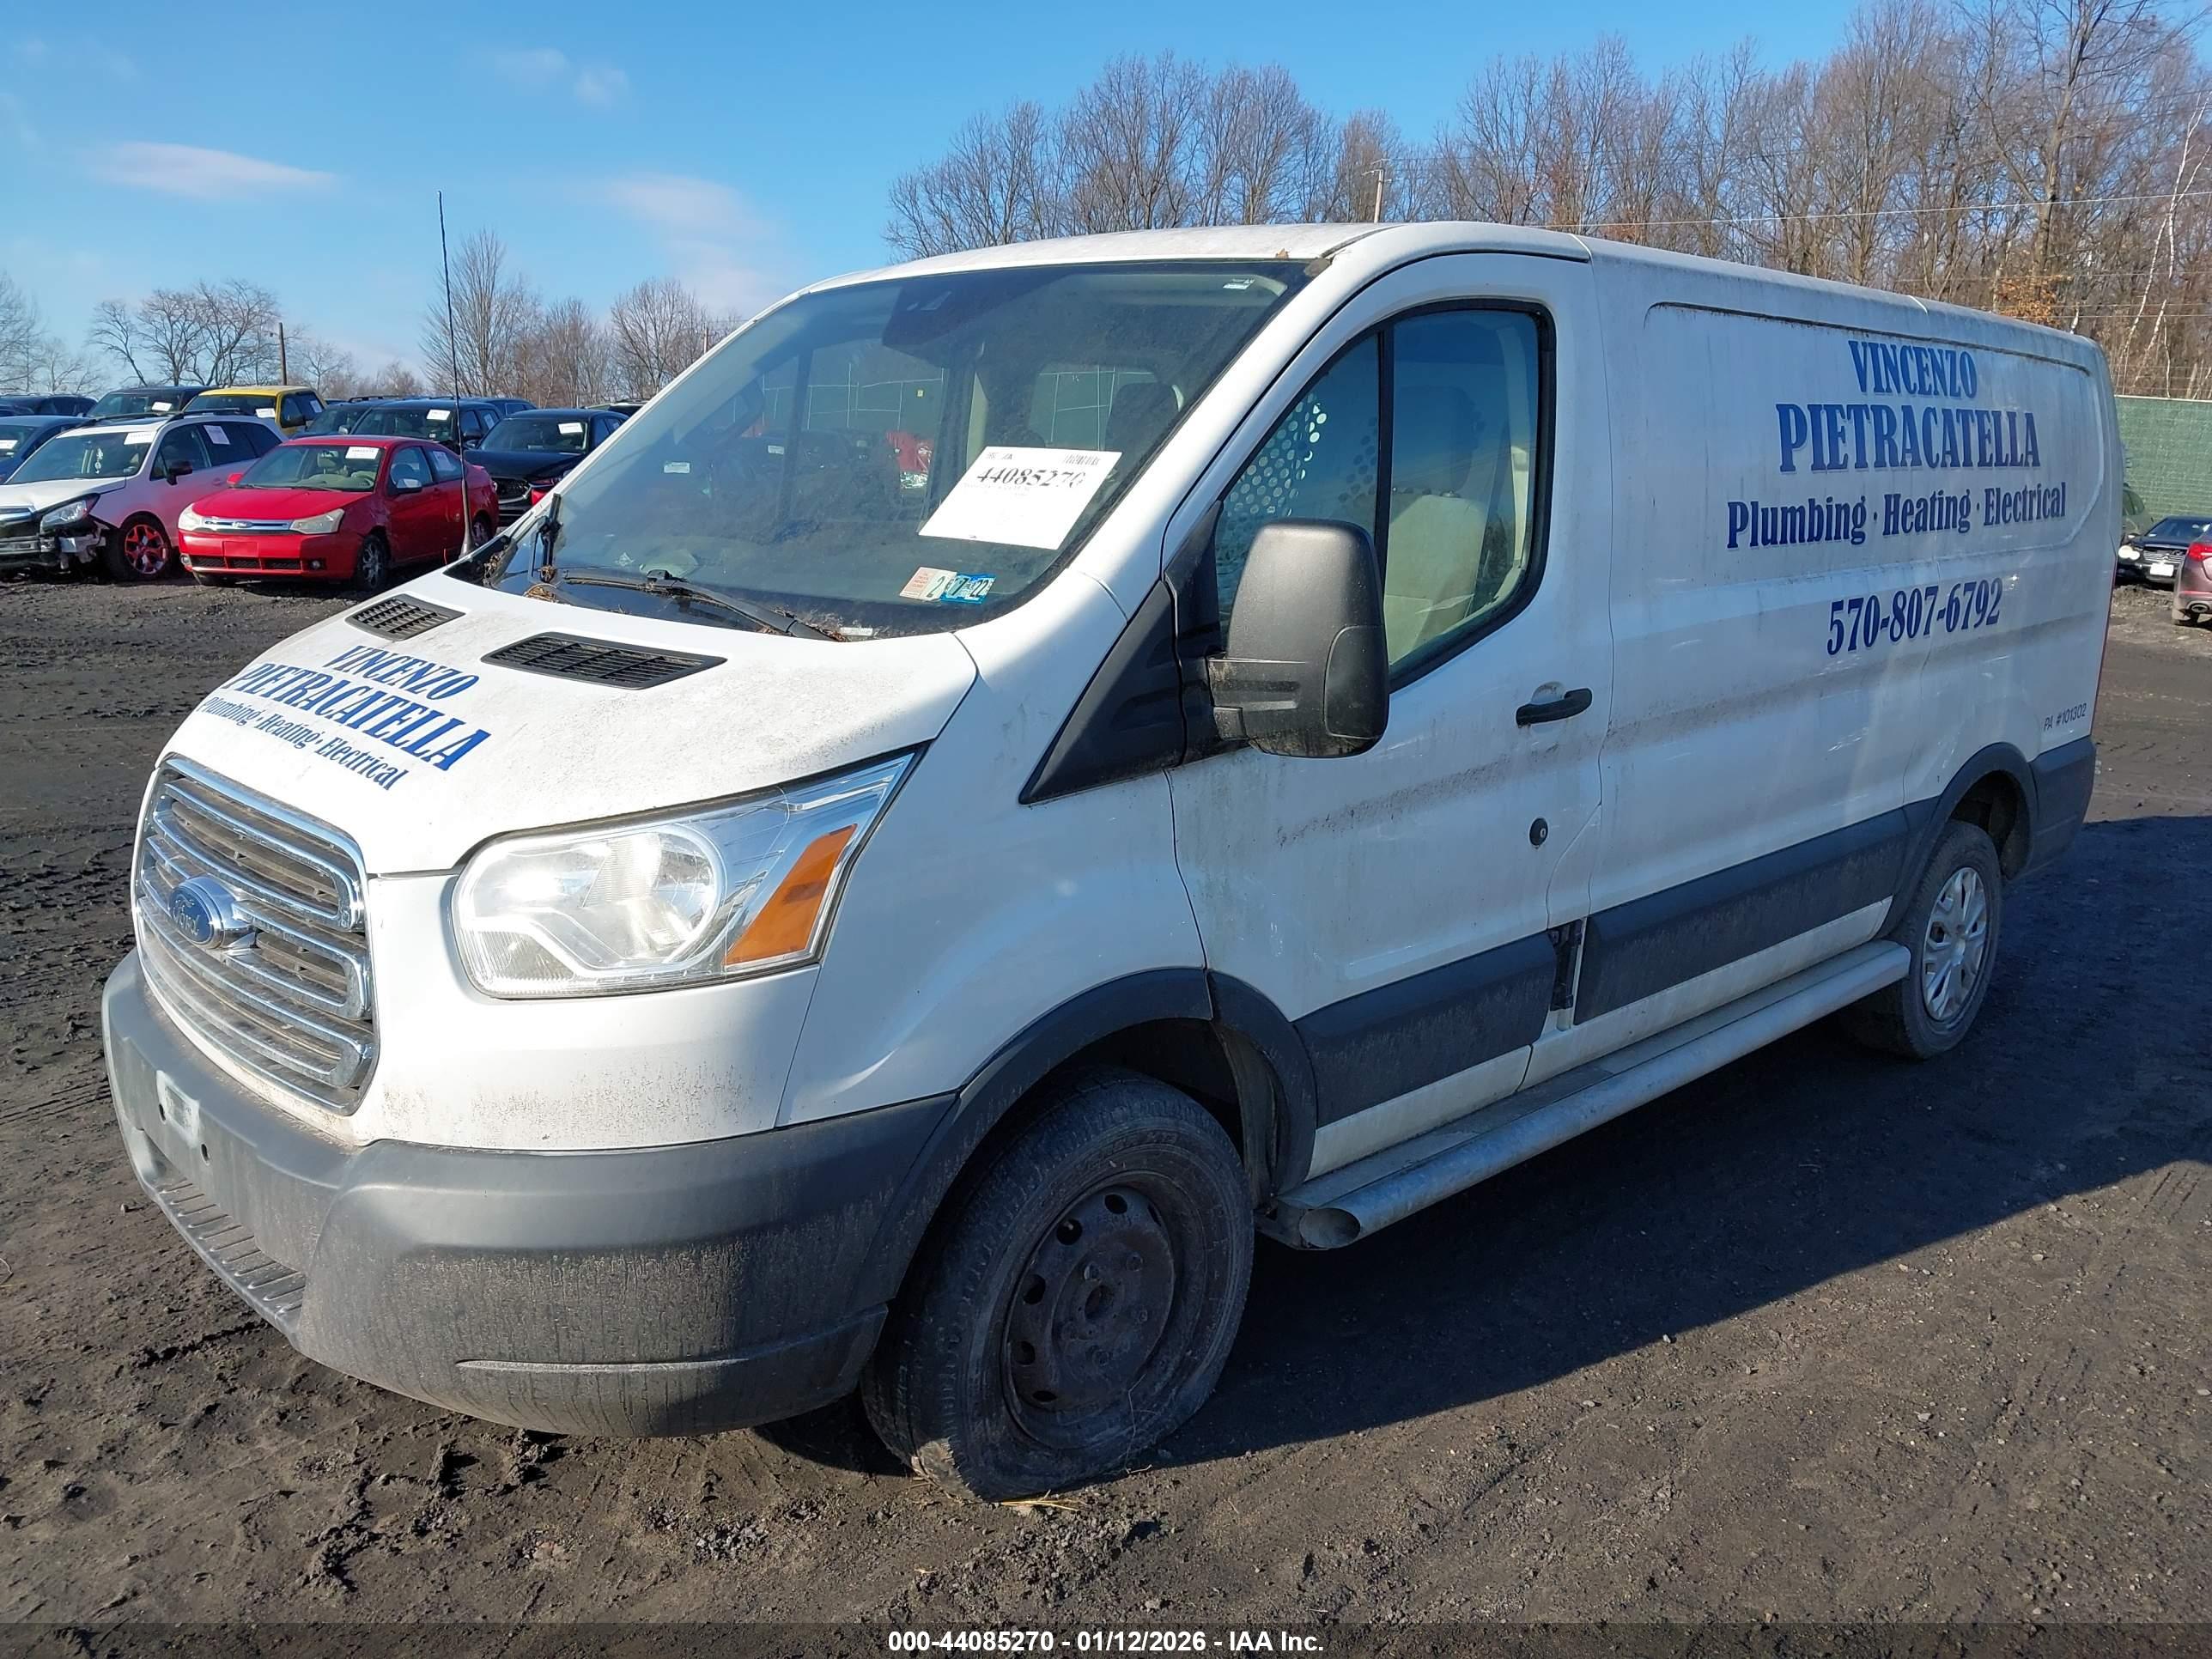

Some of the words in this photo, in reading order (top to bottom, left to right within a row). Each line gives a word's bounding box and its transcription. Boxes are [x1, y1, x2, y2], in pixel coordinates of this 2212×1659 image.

[1848, 340, 1978, 399] VINCENZO
[1775, 403, 2041, 472] PIETRACATELLA
[1727, 495, 1867, 549] Plumbing
[1882, 489, 1972, 536] Heating
[1984, 482, 2067, 526] Electrical
[1826, 577, 2004, 655] 570-807-6792
[322, 645, 480, 701] VINCENZO
[196, 696, 265, 726] Plumbing
[254, 713, 325, 750] Heating
[314, 737, 410, 791] Electrical
[220, 663, 492, 771] PIETRACATELLA
[2043, 714, 2054, 732] PA
[173, 894, 201, 937] Ford
